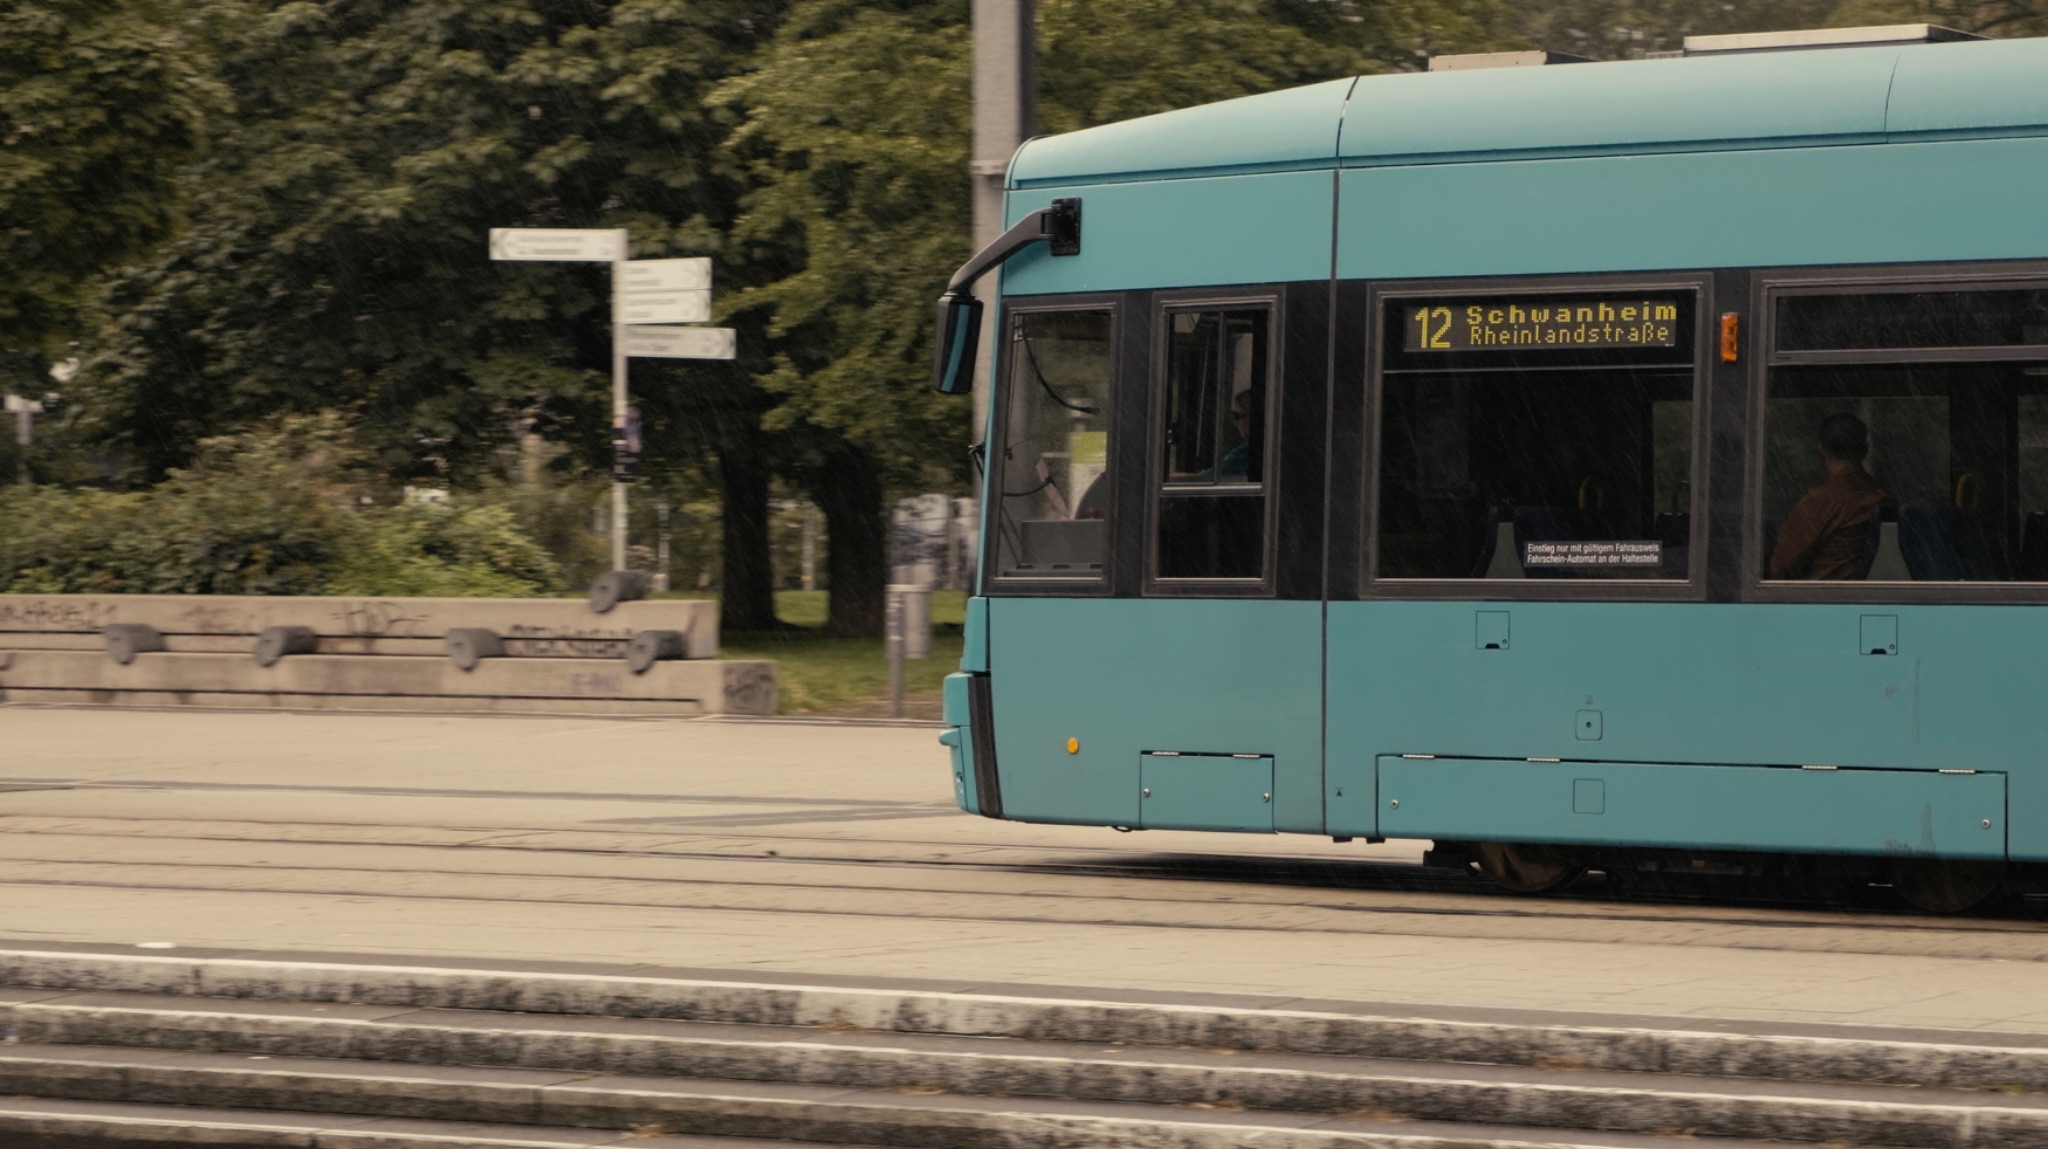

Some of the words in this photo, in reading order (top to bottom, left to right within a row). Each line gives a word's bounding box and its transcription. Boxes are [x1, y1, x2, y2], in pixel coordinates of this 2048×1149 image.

[1467, 302, 1677, 324] Schwanheim
[1415, 307, 1452, 348] 12
[1470, 322, 1669, 345] Rheinlandstraße
[1527, 543, 1555, 554] Einstieg
[1570, 544, 1582, 552] mit
[1583, 543, 1614, 554] gültigem
[1615, 543, 1659, 552] Fahrausweis
[1527, 554, 1597, 564] Fahrschein-Automat
[1598, 555, 1606, 563] an
[1608, 555, 1621, 563] der
[1622, 554, 1659, 563] Haltestelle
